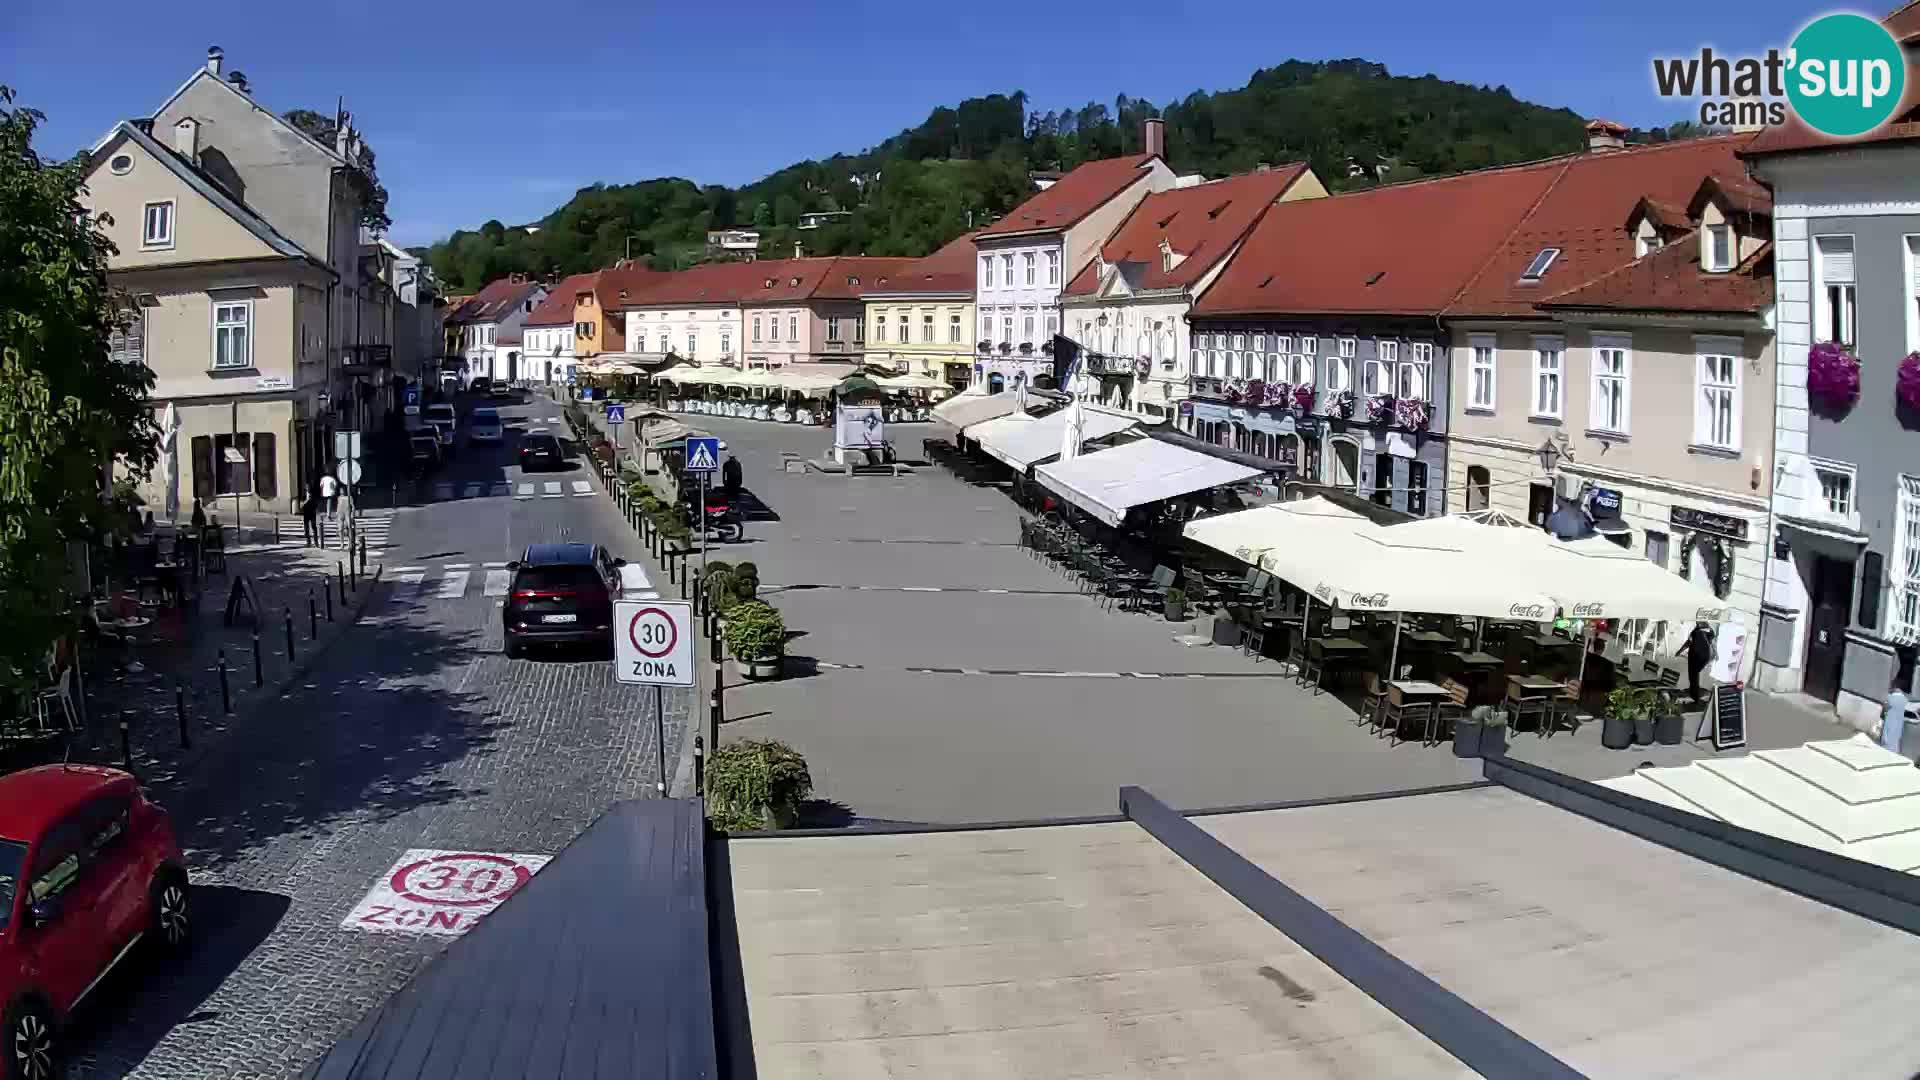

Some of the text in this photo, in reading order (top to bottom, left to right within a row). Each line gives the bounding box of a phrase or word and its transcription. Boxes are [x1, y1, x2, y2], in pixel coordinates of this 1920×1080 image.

[642, 623, 666, 645] 30
[632, 660, 677, 678] ZONA
[418, 865, 502, 894] 30
